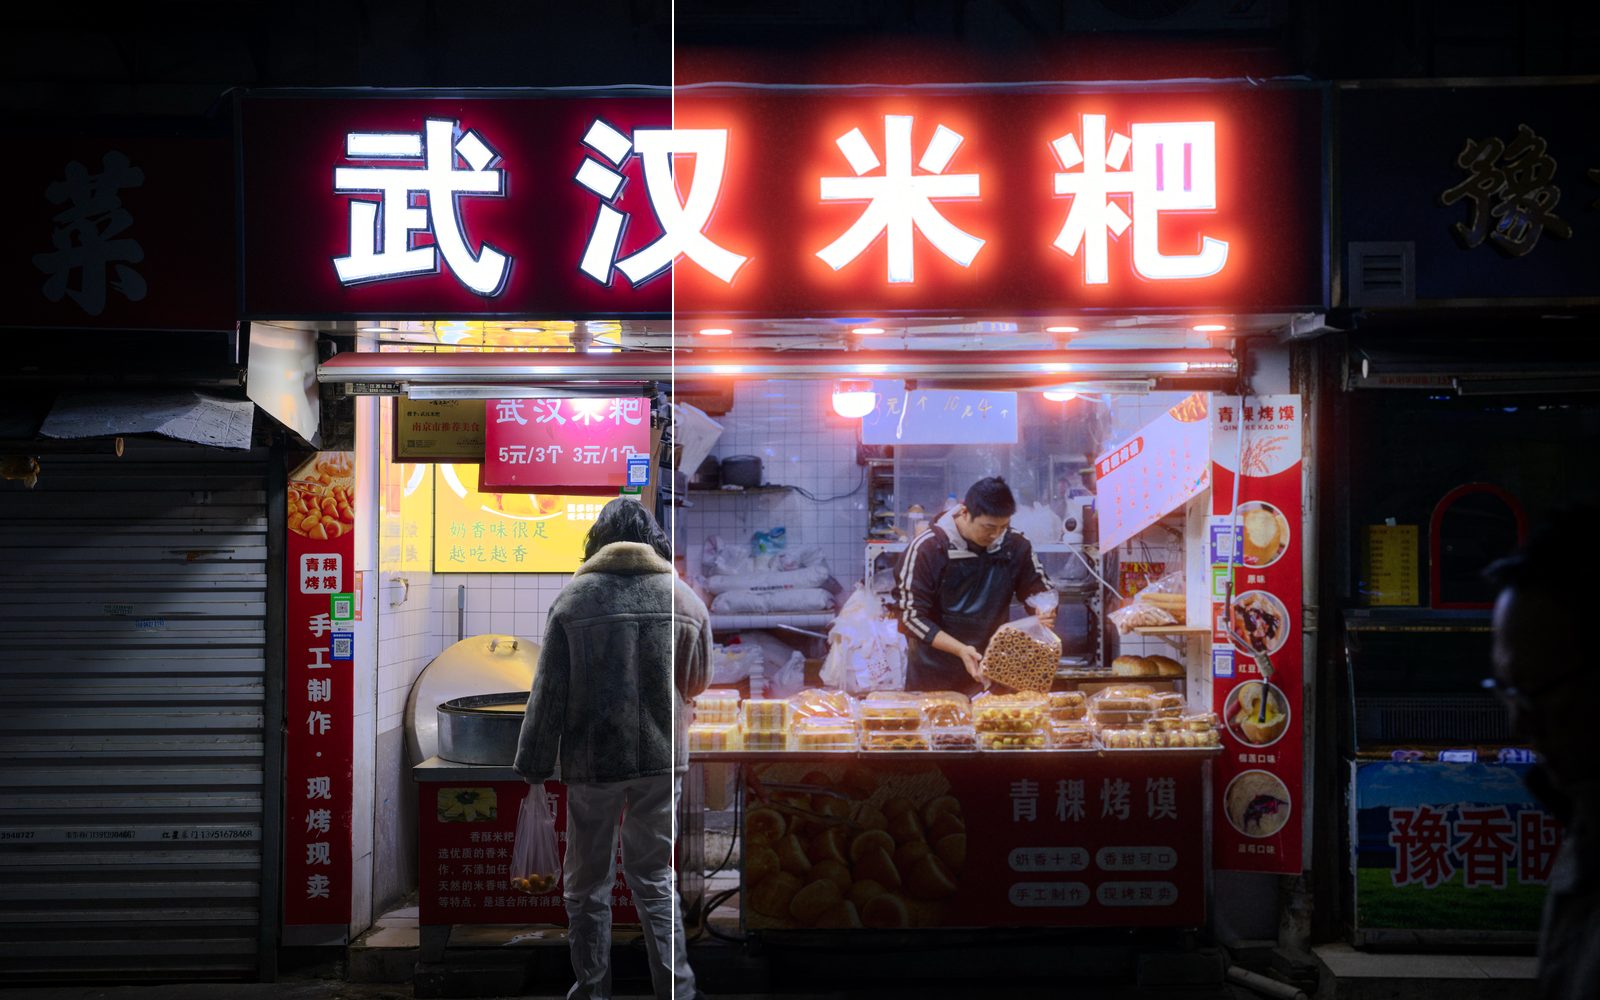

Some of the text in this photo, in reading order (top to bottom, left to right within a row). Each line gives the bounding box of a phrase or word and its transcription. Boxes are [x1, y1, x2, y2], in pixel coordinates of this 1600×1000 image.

[332, 113, 1231, 299] 武汉米粑
[496, 398, 642, 426] 武汉米粑
[499, 445, 563, 465] 5元/3个
[450, 520, 548, 539] 奶香味很足
[450, 544, 528, 563] 越吃越香
[1009, 777, 1178, 823] 青稞烤馍
